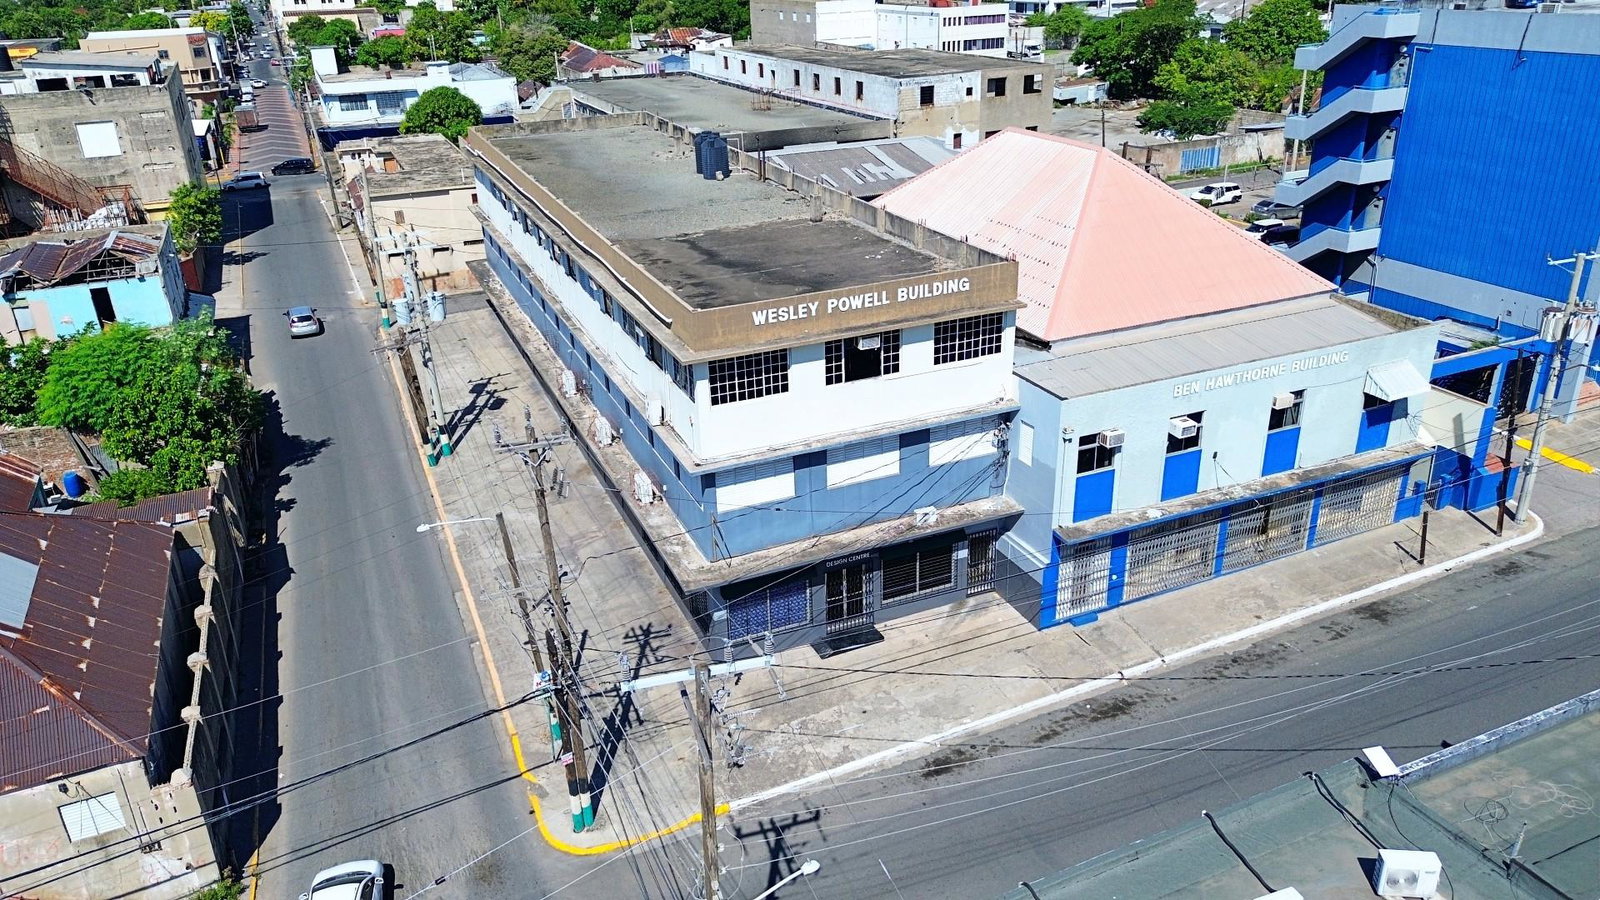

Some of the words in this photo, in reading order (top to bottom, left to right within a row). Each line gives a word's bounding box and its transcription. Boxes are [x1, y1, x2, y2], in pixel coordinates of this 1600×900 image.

[752, 302, 818, 325] WESLEY
[828, 291, 890, 313] POWELL
[898, 277, 970, 302] BUILDING
[1173, 381, 1200, 398] BEN
[1205, 363, 1287, 390] HAWTHORNE
[1292, 351, 1349, 372] BUILDING
[826, 558, 847, 567] DESIGN
[848, 552, 870, 562] CENTRE
